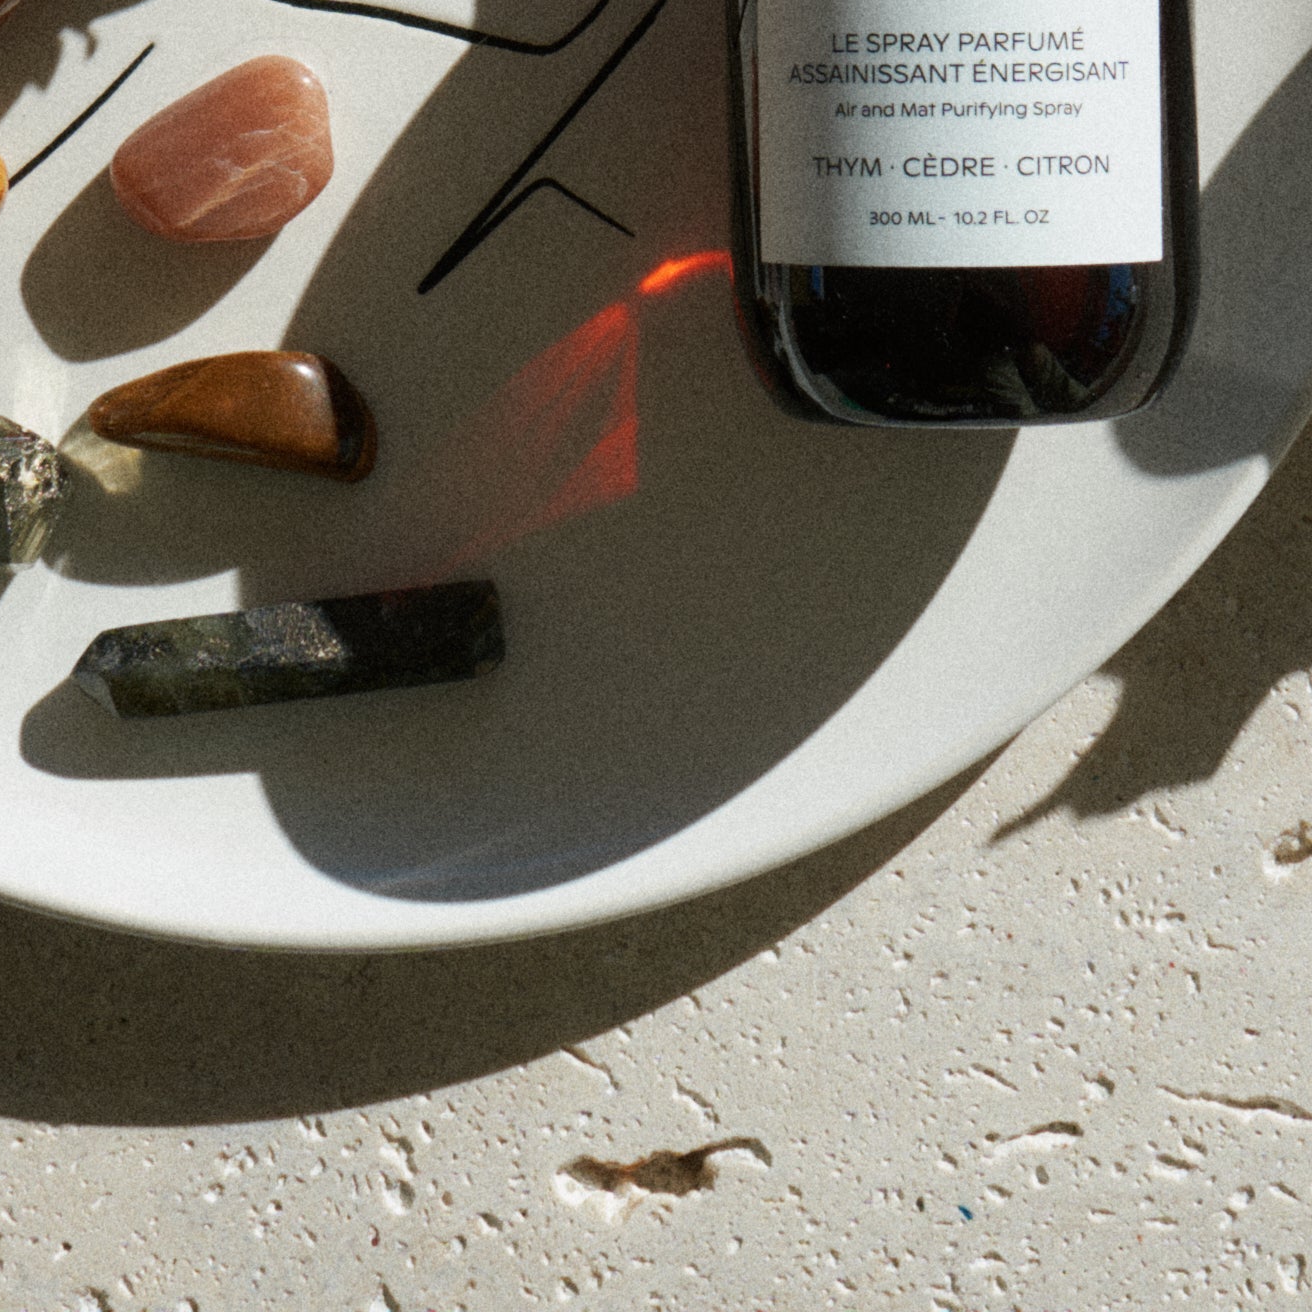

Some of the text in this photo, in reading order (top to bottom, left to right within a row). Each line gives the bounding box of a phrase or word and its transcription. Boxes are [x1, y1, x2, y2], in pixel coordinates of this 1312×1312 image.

[830, 26, 1085, 55] LE SPRAY PARFUMÉ
[789, 57, 1129, 86] ASSAINISSANT ÉNERGISANT
[834, 100, 1083, 120] Air and Mat Purifying Spray
[812, 155, 883, 179] THYM
[902, 152, 996, 179] CÈDRE
[1016, 154, 1110, 178] CITRON
[869, 210, 903, 226] 300
[953, 210, 988, 226] 10.2
[993, 209, 1020, 225] FL.
[1023, 208, 1050, 225] OZ
